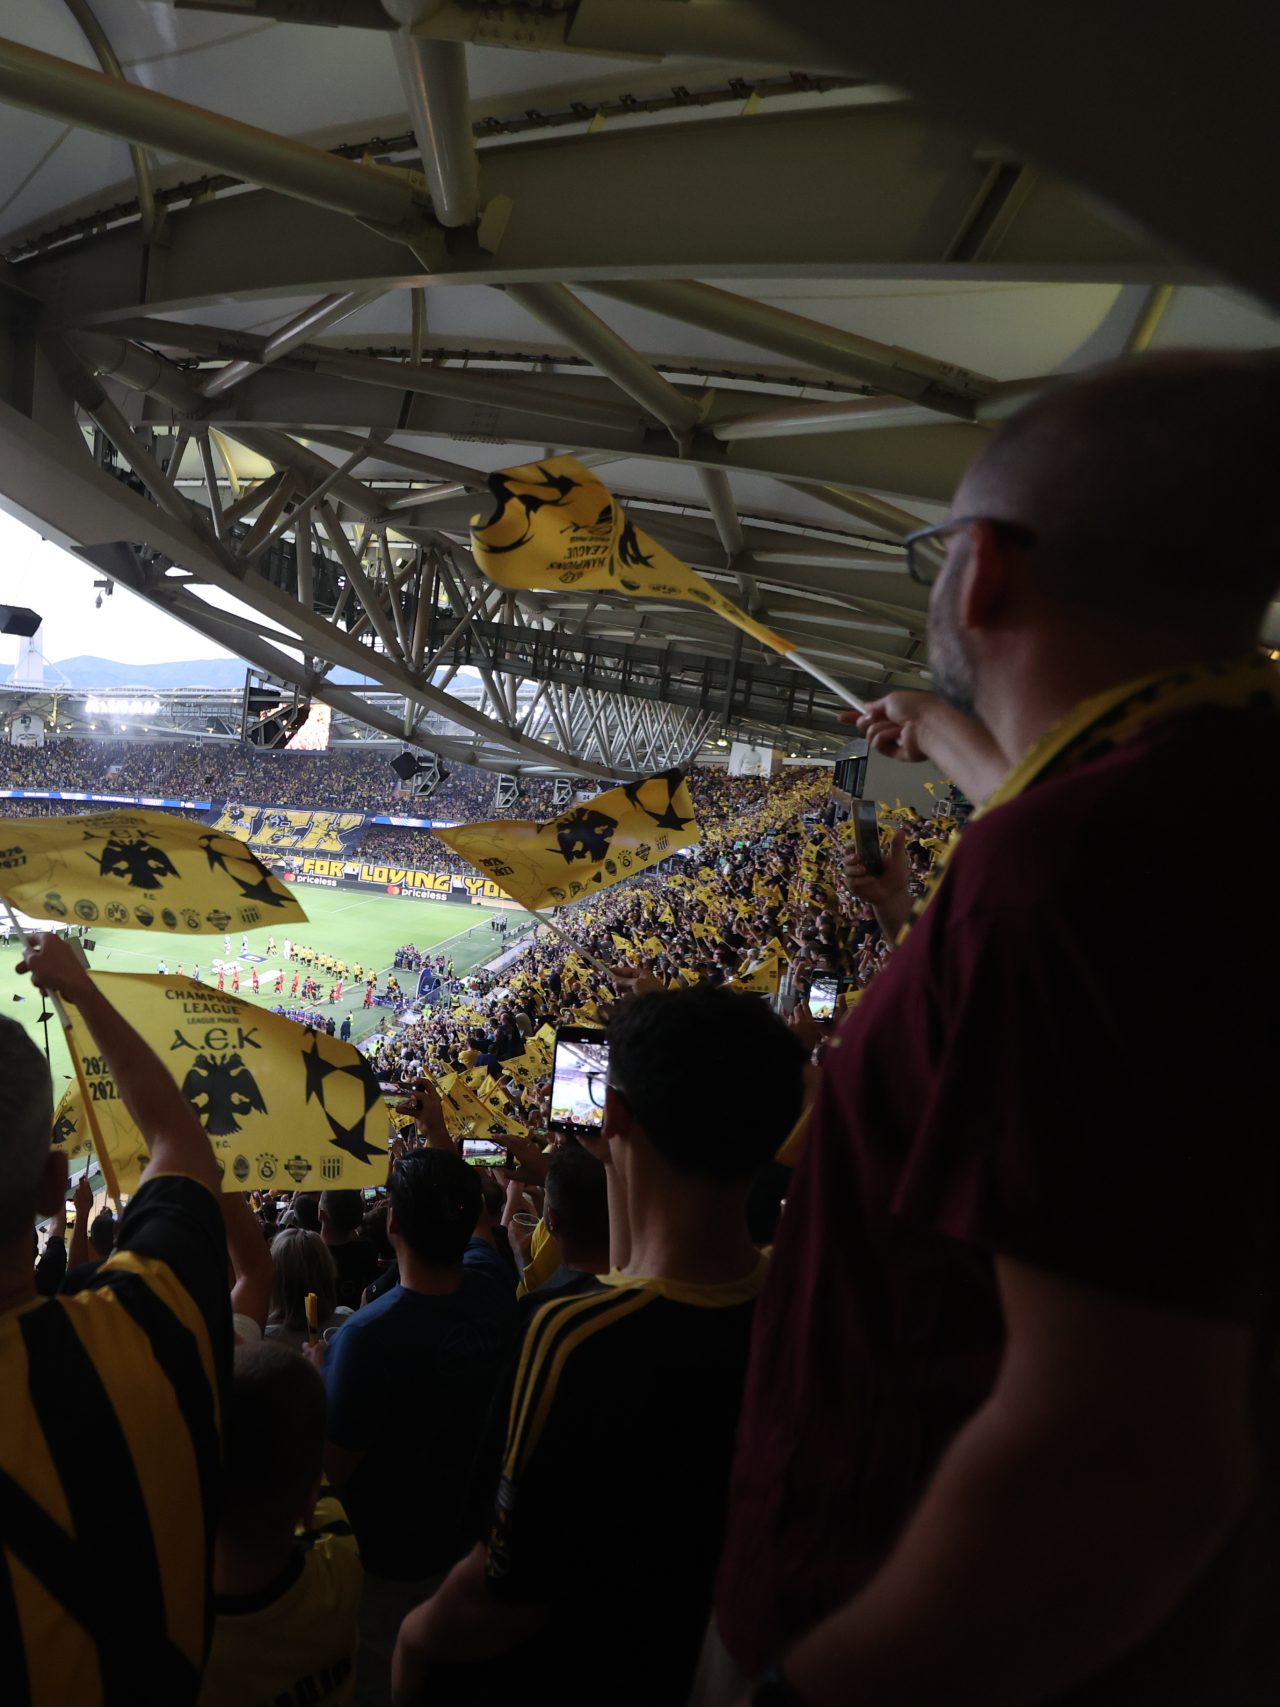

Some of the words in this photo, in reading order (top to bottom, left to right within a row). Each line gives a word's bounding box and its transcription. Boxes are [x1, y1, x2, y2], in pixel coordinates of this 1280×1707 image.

[296, 875, 338, 887] priceless
[303, 858, 345, 878] FOR
[361, 864, 452, 892] LOVING
[401, 888, 448, 901] priceless
[183, 1003, 241, 1015] LEAGUE
[82, 1056, 111, 1076] 202
[89, 1081, 121, 1101] 202
